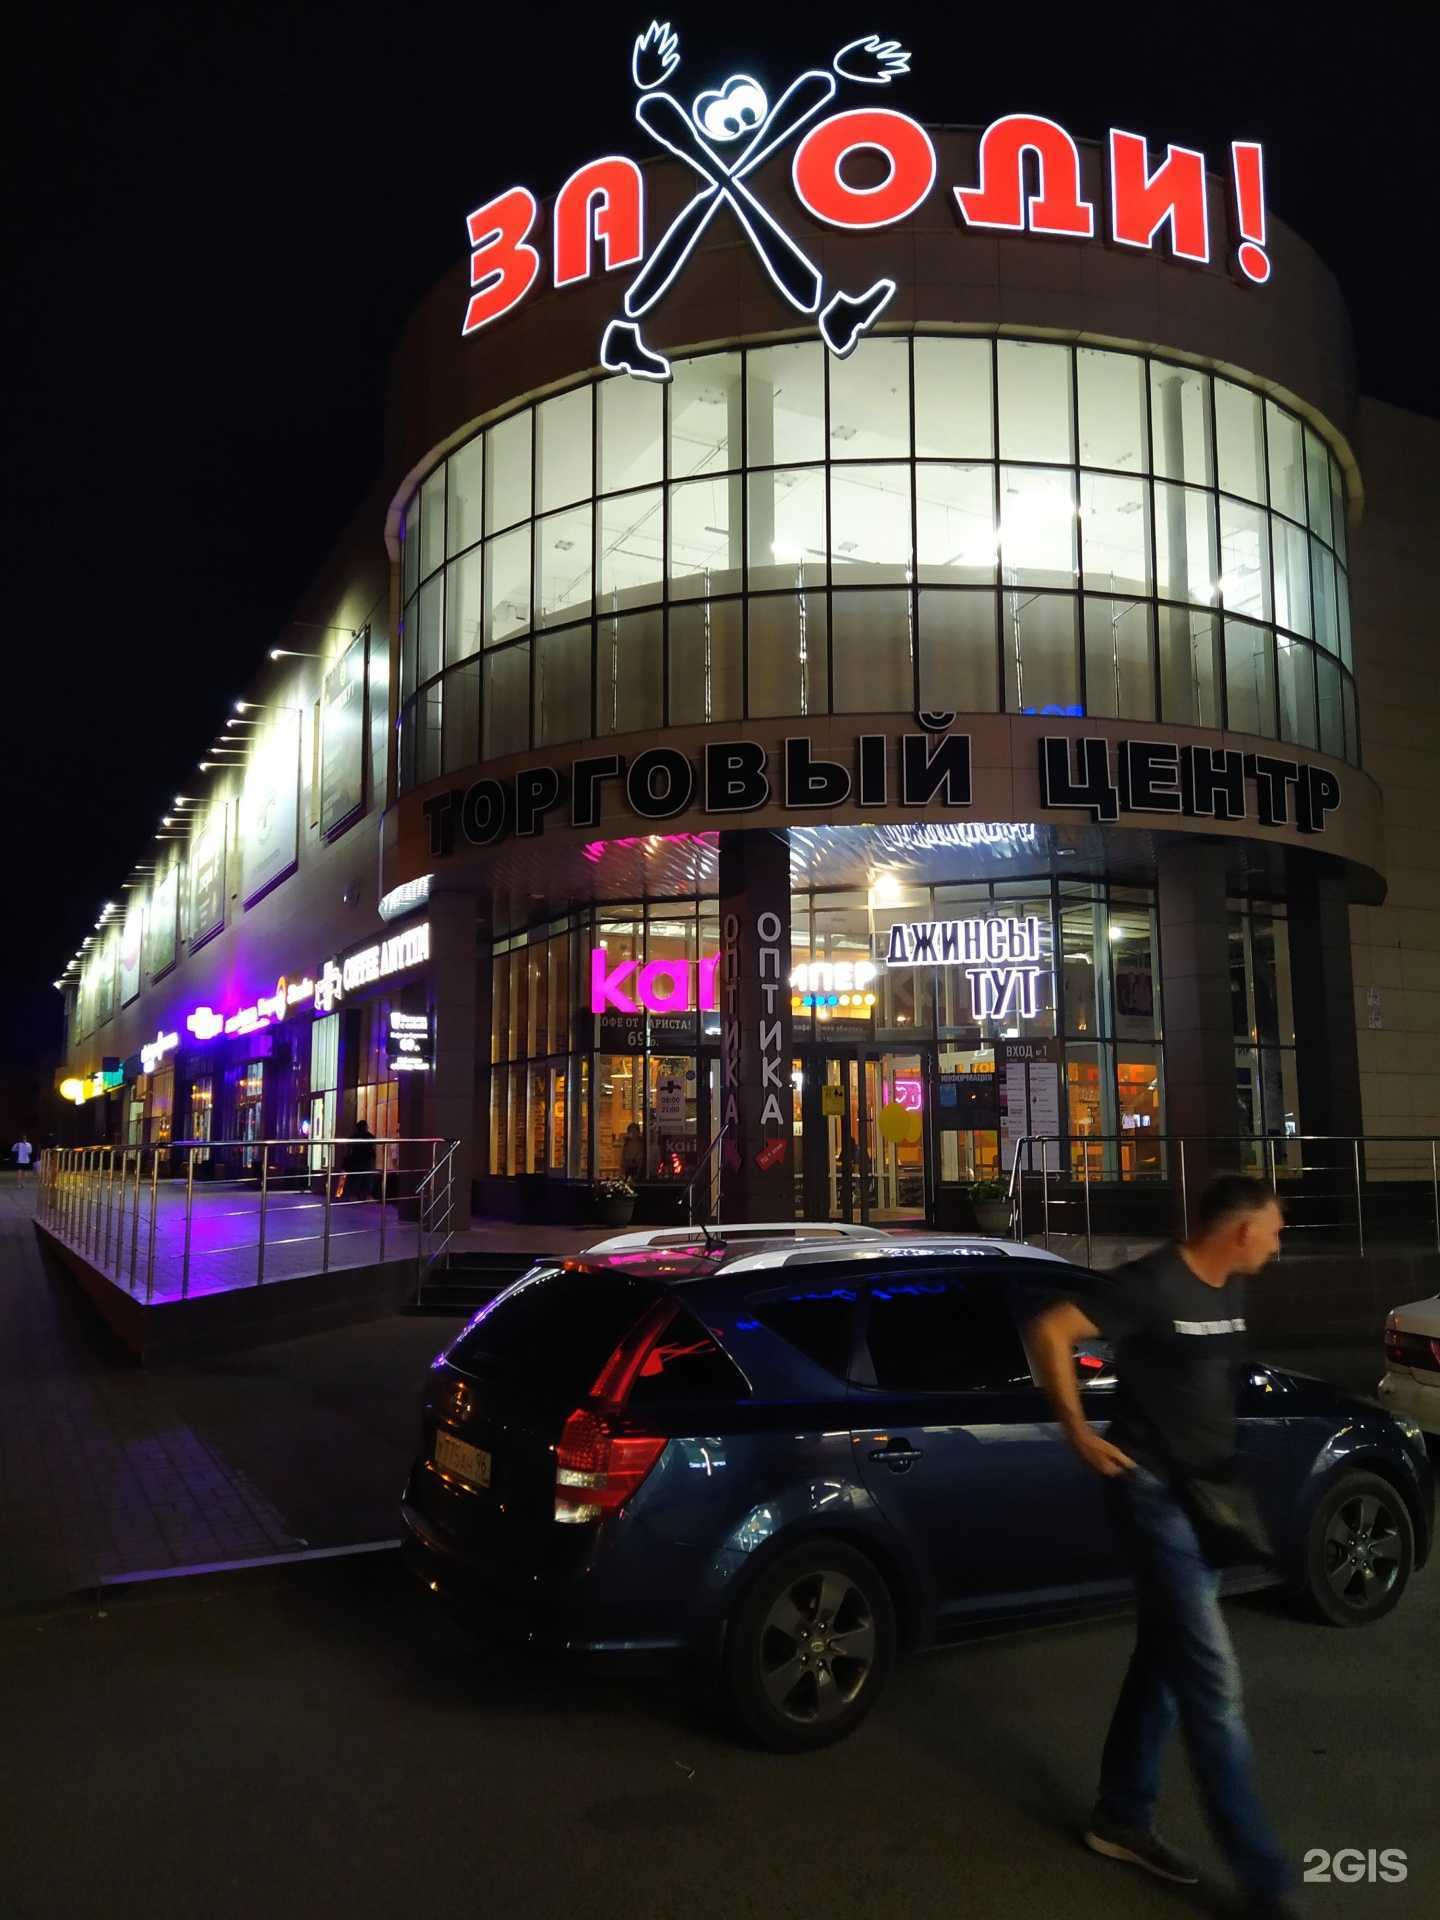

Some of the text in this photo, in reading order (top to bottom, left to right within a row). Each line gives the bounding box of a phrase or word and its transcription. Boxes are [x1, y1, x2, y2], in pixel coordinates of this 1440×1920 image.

[424, 711, 1341, 855] ТОРГОВЫЙ ЦЕНТР
[886, 916, 1040, 967] ДЖИНСЫ
[591, 948, 721, 1014] kar
[789, 961, 877, 992] ИПЕР
[965, 966, 1040, 1020] ТУТ
[598, 1016, 623, 1028] ОФЕ
[641, 1018, 692, 1031] АРИСТА!
[723, 913, 739, 1125] ОПТИКА
[757, 912, 784, 1125] ОПТИКА
[1006, 1045, 1033, 1058] ВХОД
